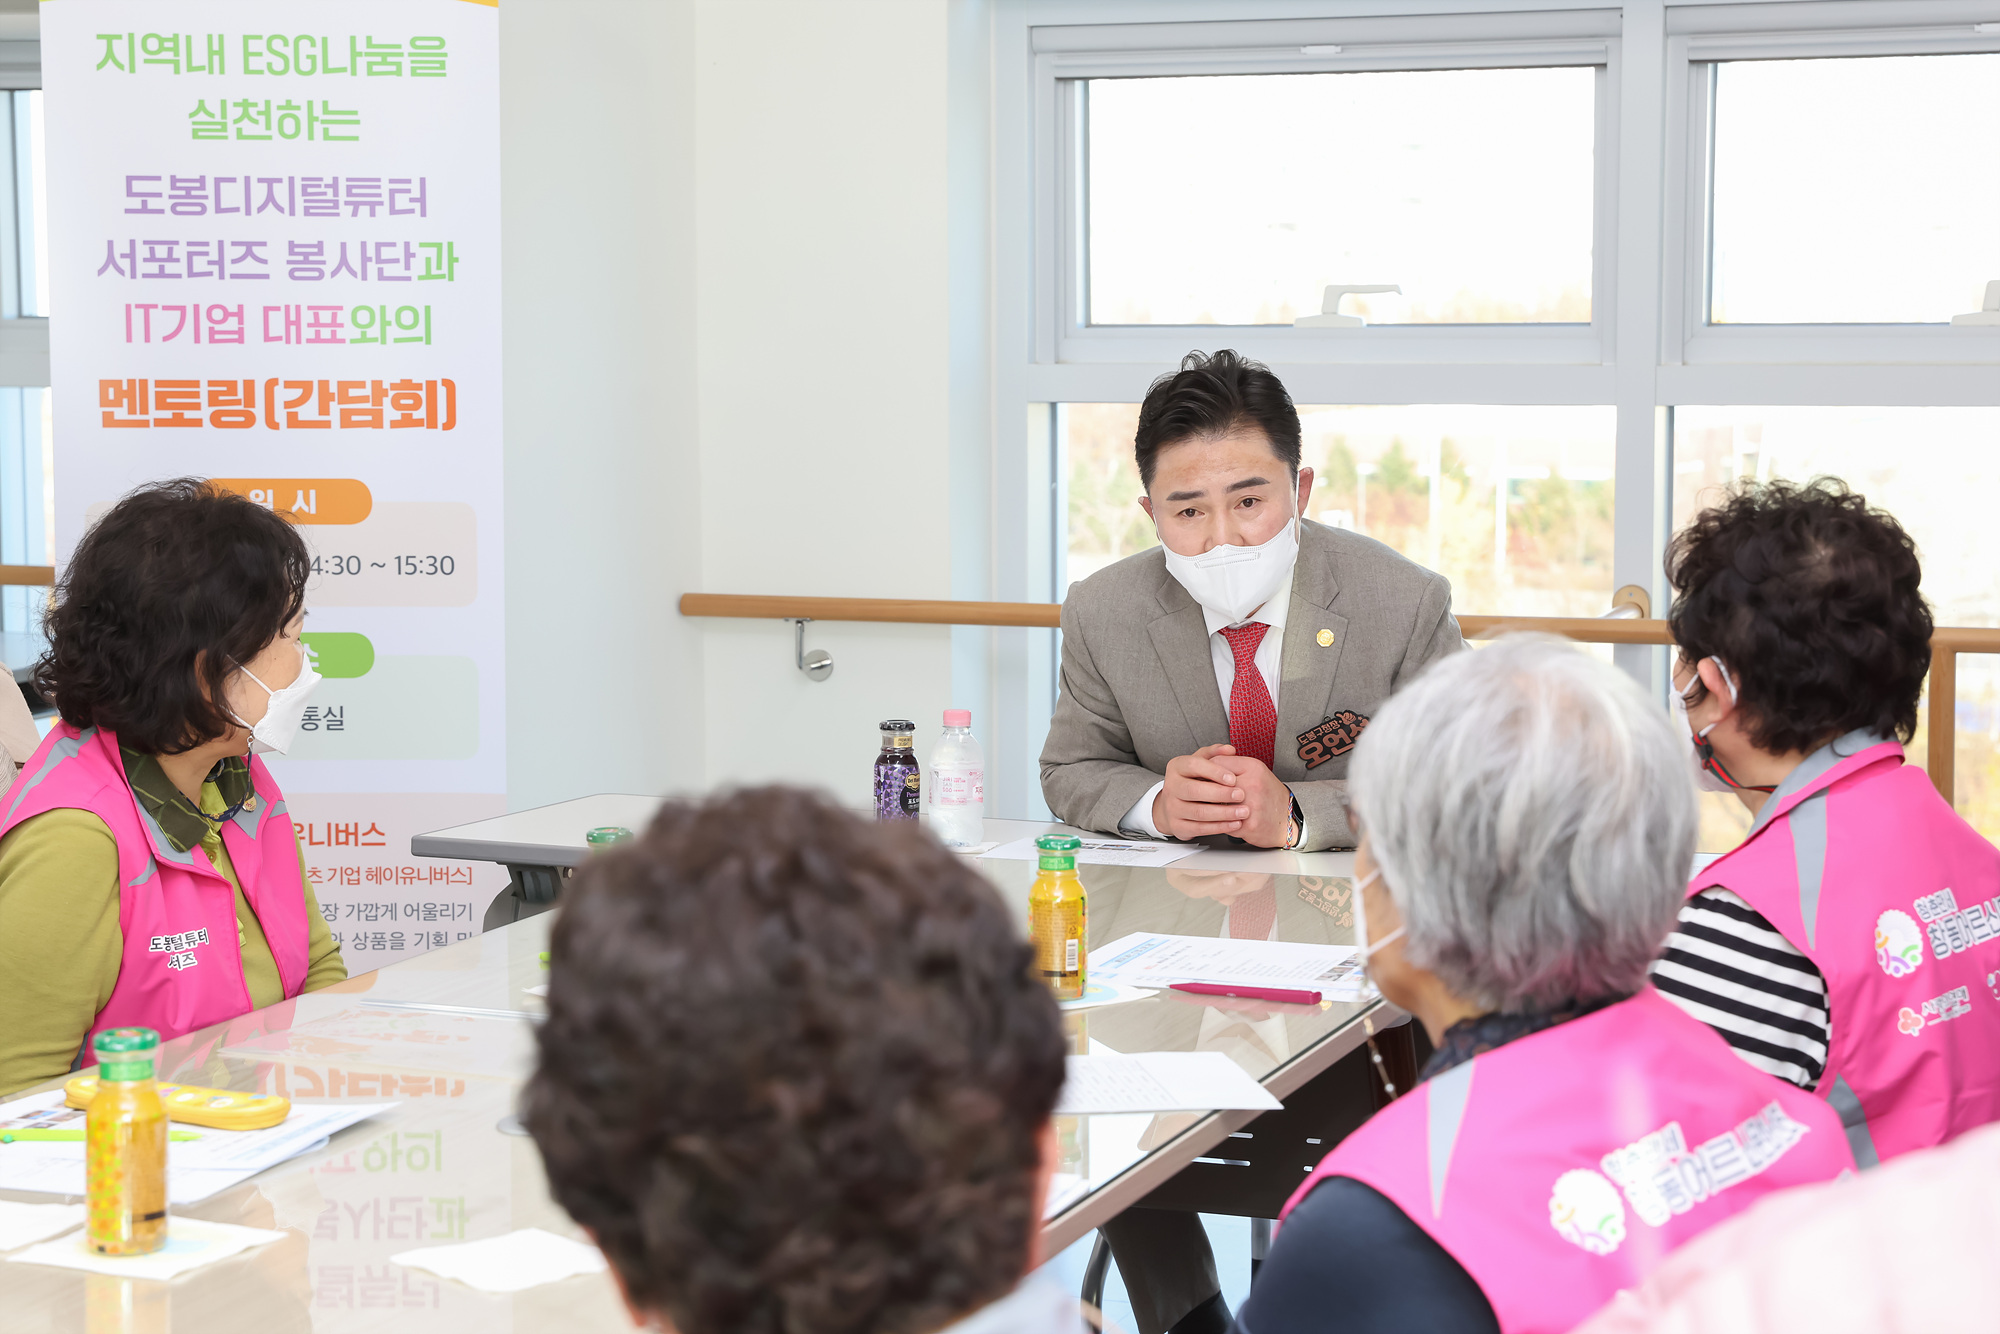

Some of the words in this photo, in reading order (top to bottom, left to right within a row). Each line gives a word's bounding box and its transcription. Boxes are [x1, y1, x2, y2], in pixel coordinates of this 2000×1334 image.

[96, 32, 226, 75] 지역내
[242, 34, 448, 77] ESG나눔을
[188, 99, 361, 142] 실천하는
[124, 175, 427, 218] 도봉디지털튜터
[97, 239, 270, 281] 서포터즈
[286, 240, 459, 282] 봉사단과
[125, 304, 245, 345] IT기업
[262, 305, 432, 345] 대표와의
[99, 378, 457, 431] 멘토링(간담회)
[291, 489, 317, 515] 시
[394, 556, 455, 575] 15:30
[1298, 720, 1340, 745] 도봉구청장
[327, 866, 361, 886] 기업
[365, 866, 473, 886] 헤이유니버스]
[345, 902, 397, 922] 가깝게
[403, 902, 473, 922] 어울리기
[1927, 898, 2000, 956] 창동어르신
[351, 931, 406, 950] 상품을
[413, 931, 448, 950] 기획
